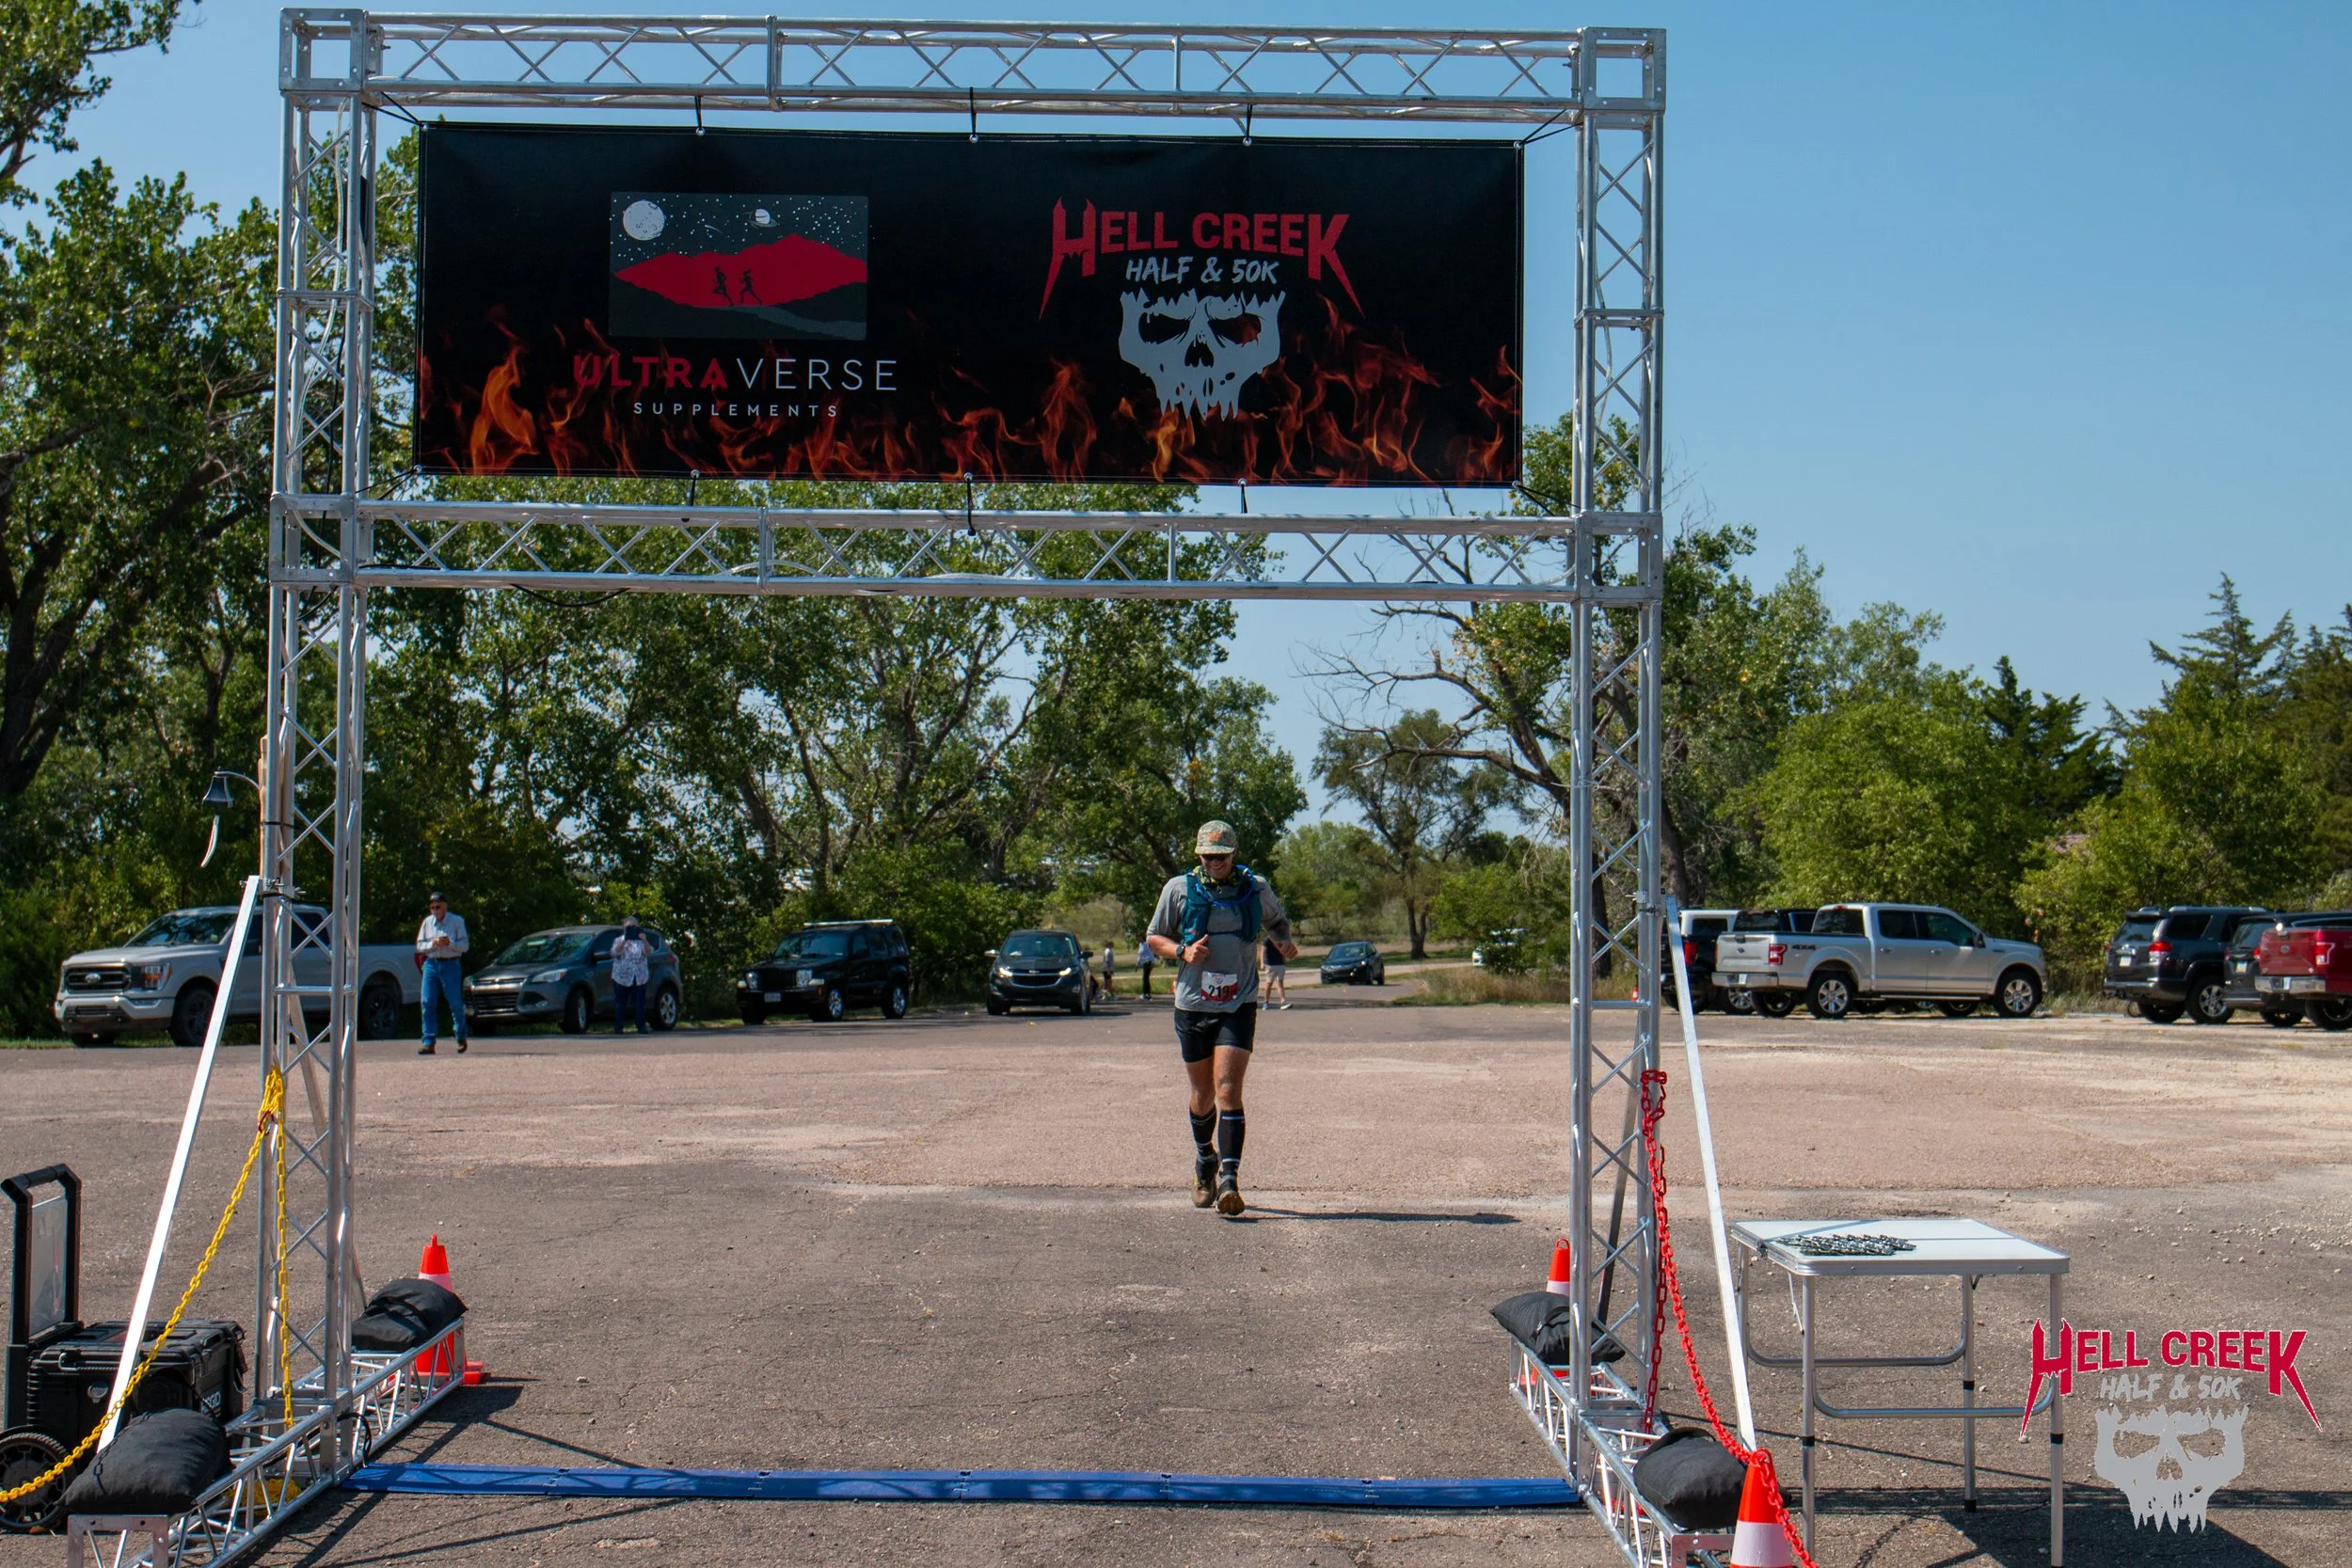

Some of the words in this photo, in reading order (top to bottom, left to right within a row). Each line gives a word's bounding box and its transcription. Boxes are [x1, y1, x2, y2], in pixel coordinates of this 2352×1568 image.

[1039, 197, 1178, 322] HELL
[1192, 211, 1365, 319] CREEK
[1125, 256, 1193, 285] HALF
[1200, 257, 1222, 283] &
[1231, 260, 1279, 285] 50K
[573, 356, 898, 391] ULTRAVERSE
[633, 403, 838, 418] SUPPLEMENTS
[1208, 984, 1230, 997] 219
